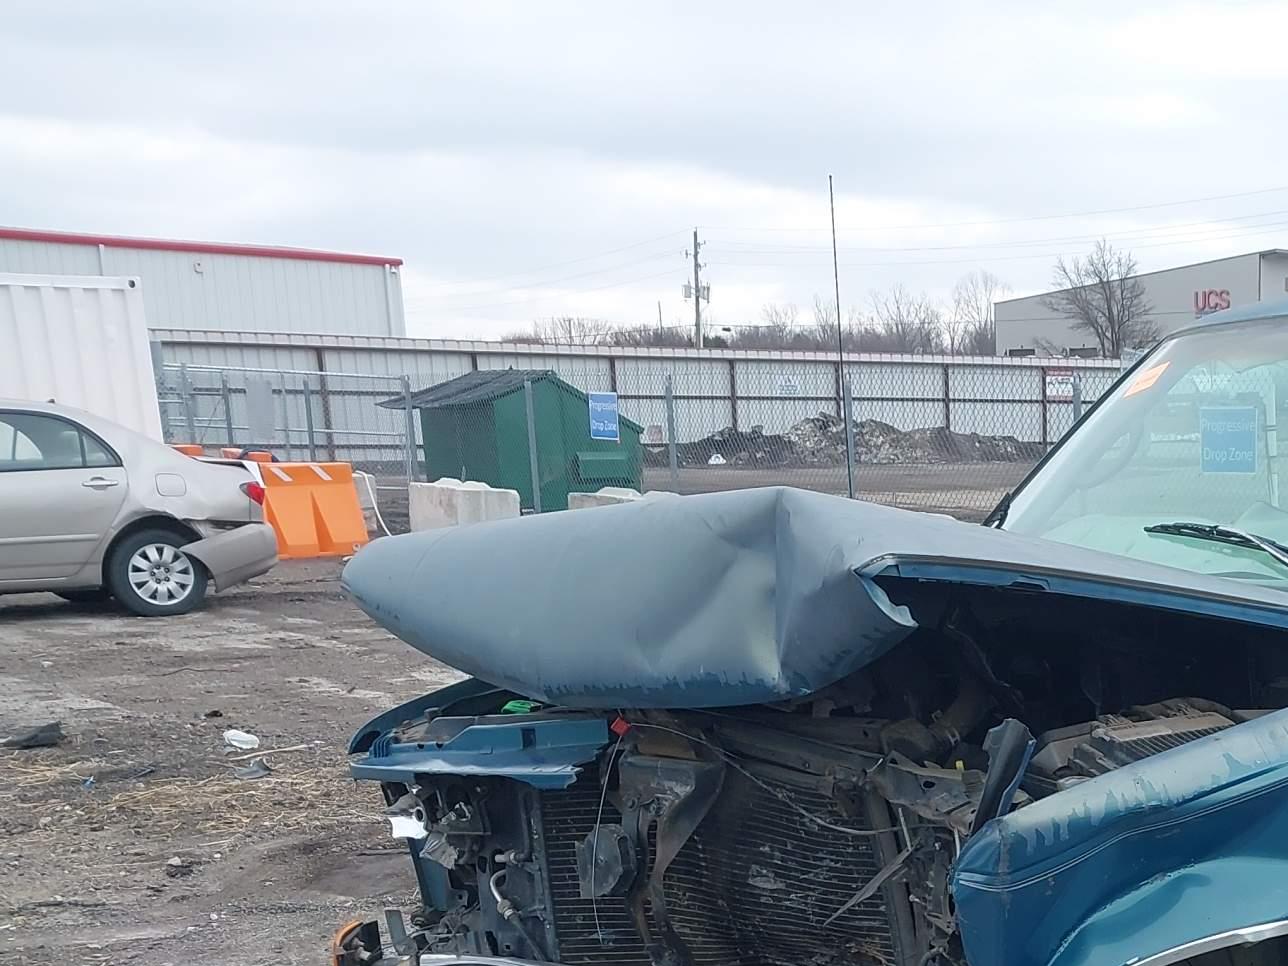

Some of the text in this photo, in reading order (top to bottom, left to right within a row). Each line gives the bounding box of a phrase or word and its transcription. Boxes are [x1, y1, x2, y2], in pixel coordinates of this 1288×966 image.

[1194, 289, 1231, 311] UCS
[1203, 447, 1254, 464] Drop Zone
